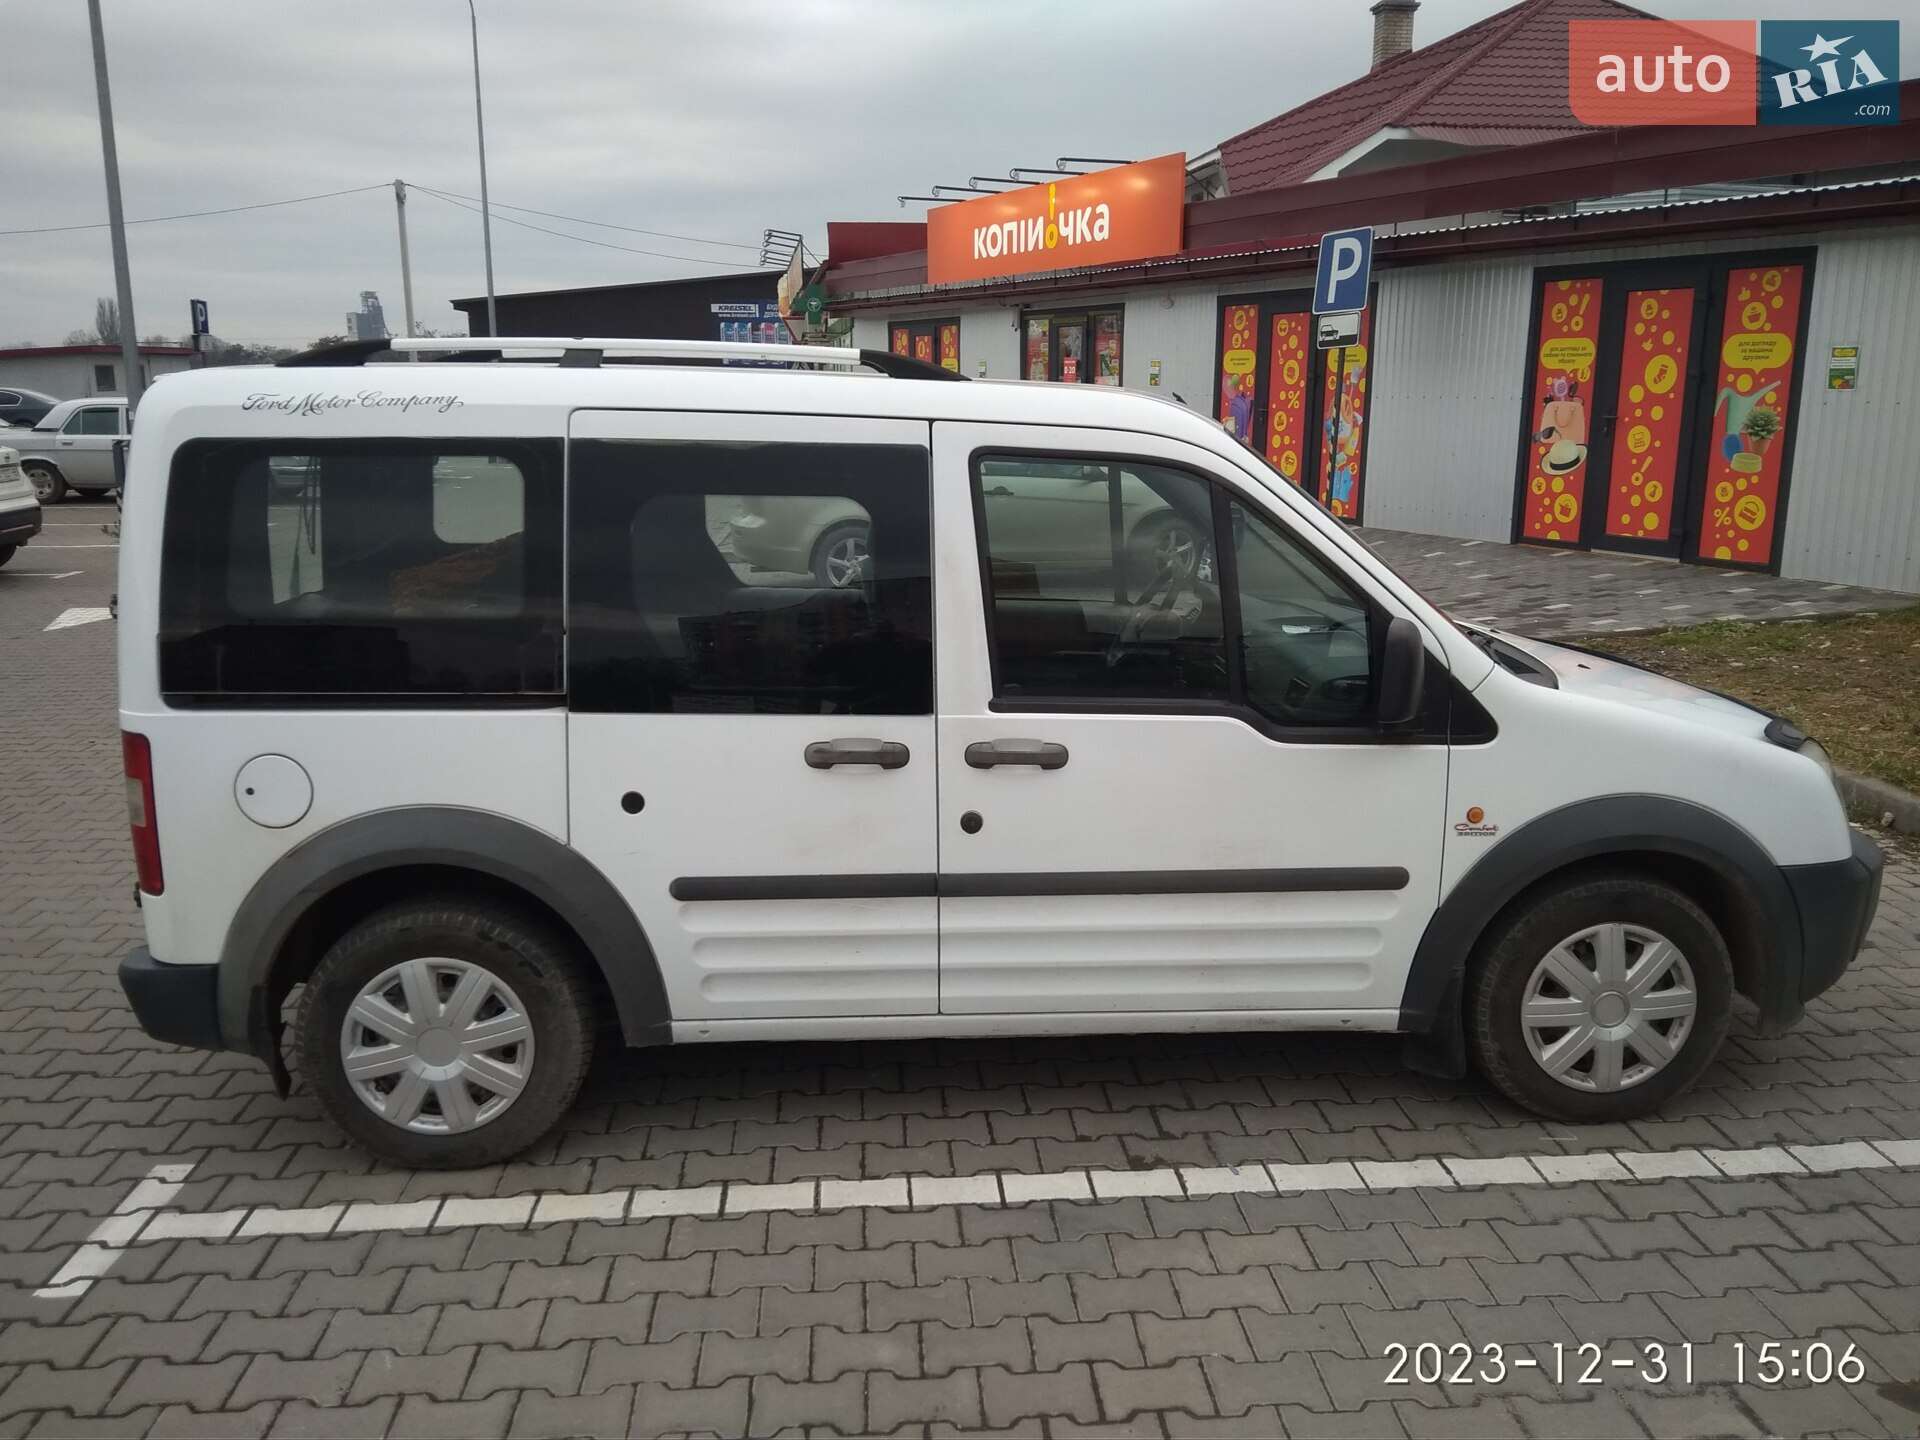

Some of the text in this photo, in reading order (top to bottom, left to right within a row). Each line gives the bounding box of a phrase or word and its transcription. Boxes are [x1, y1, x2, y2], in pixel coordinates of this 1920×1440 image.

[1327, 236, 1363, 304] P
[197, 303, 206, 331] P
[242, 390, 465, 417] Ford Motor Company
